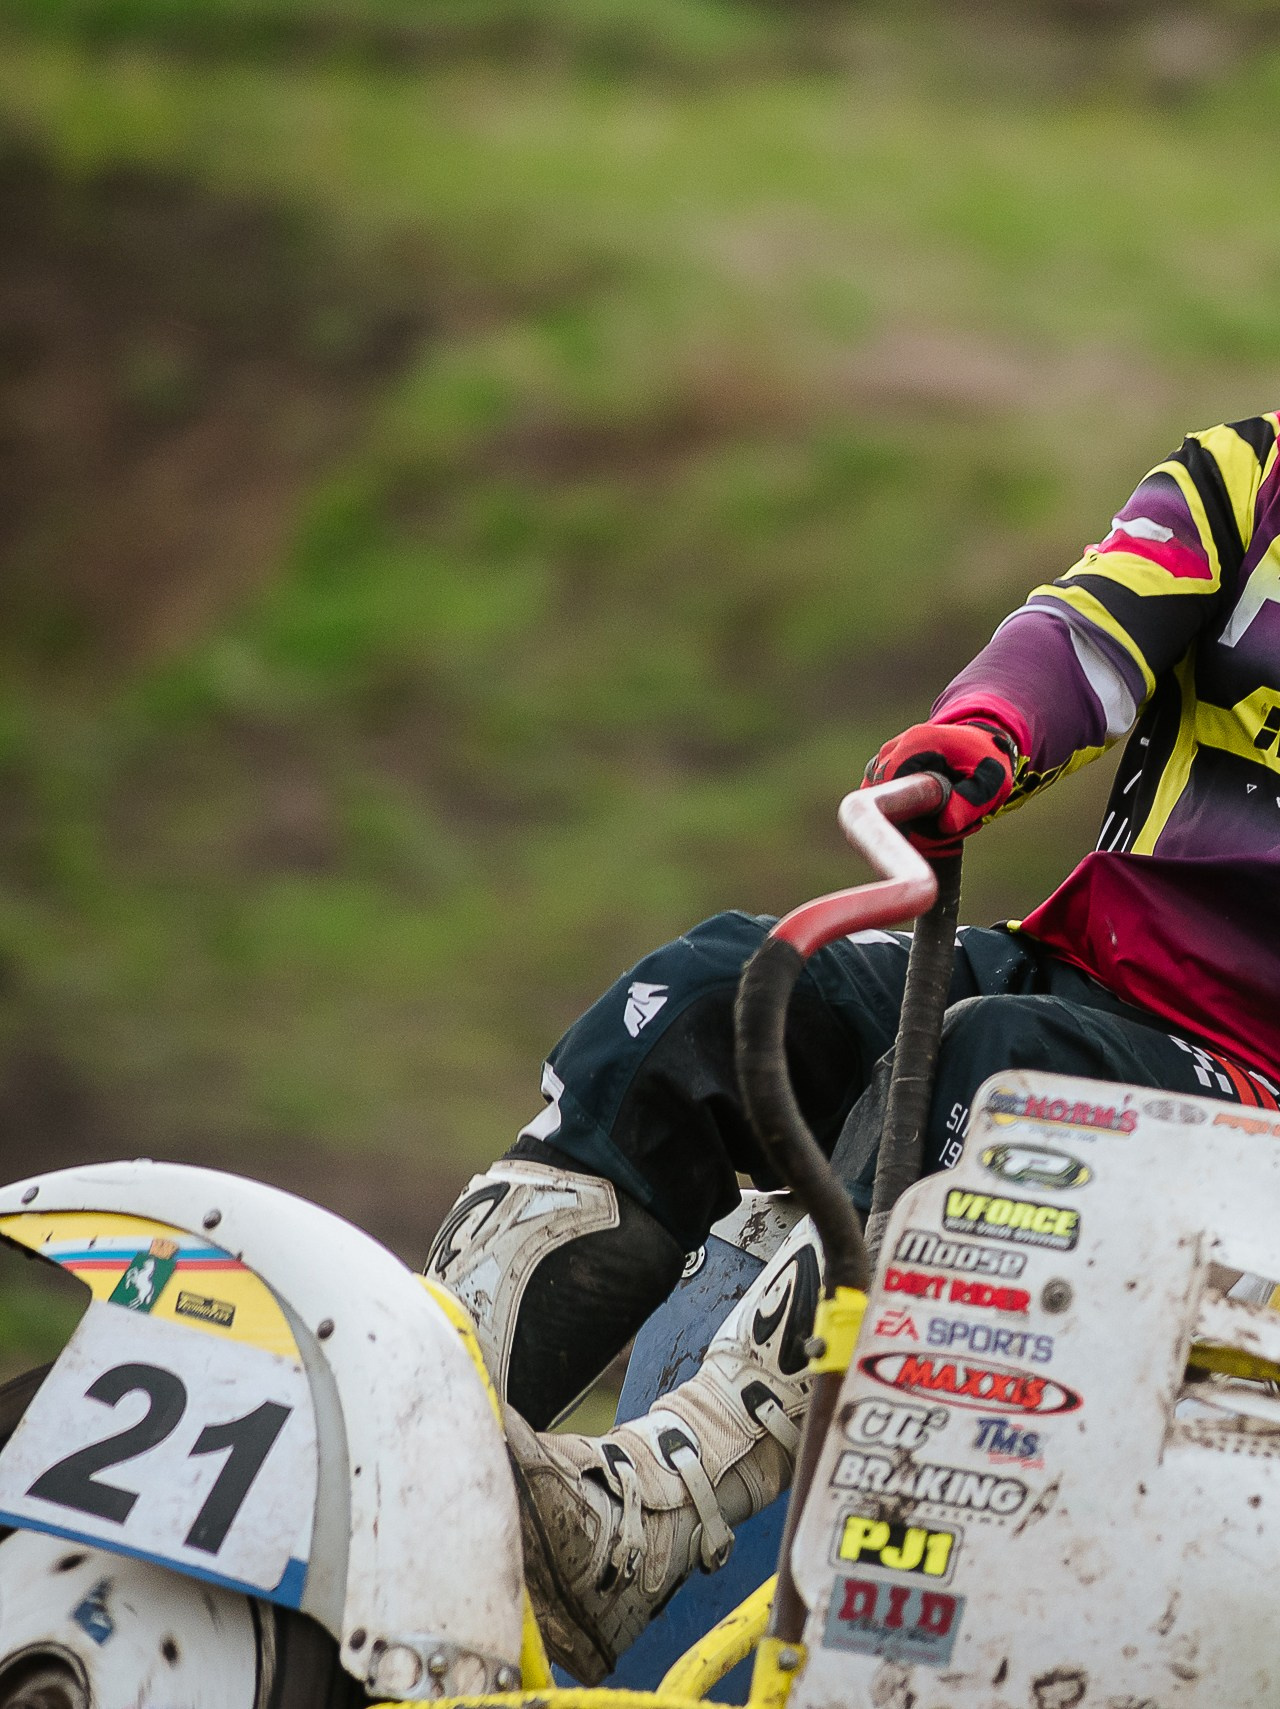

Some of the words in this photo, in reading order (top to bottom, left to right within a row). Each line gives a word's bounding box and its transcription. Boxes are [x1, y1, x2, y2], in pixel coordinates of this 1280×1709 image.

[946, 1190, 1080, 1238] VFORCE
[874, 1310, 919, 1342] EA
[926, 1316, 1054, 1364] SPORTS
[894, 1354, 1048, 1409] MAXXIS
[25, 1362, 293, 1556] 21
[974, 1416, 1042, 1457] TMS
[832, 1450, 1029, 1516] BRAKING
[839, 1515, 955, 1577] PJ1
